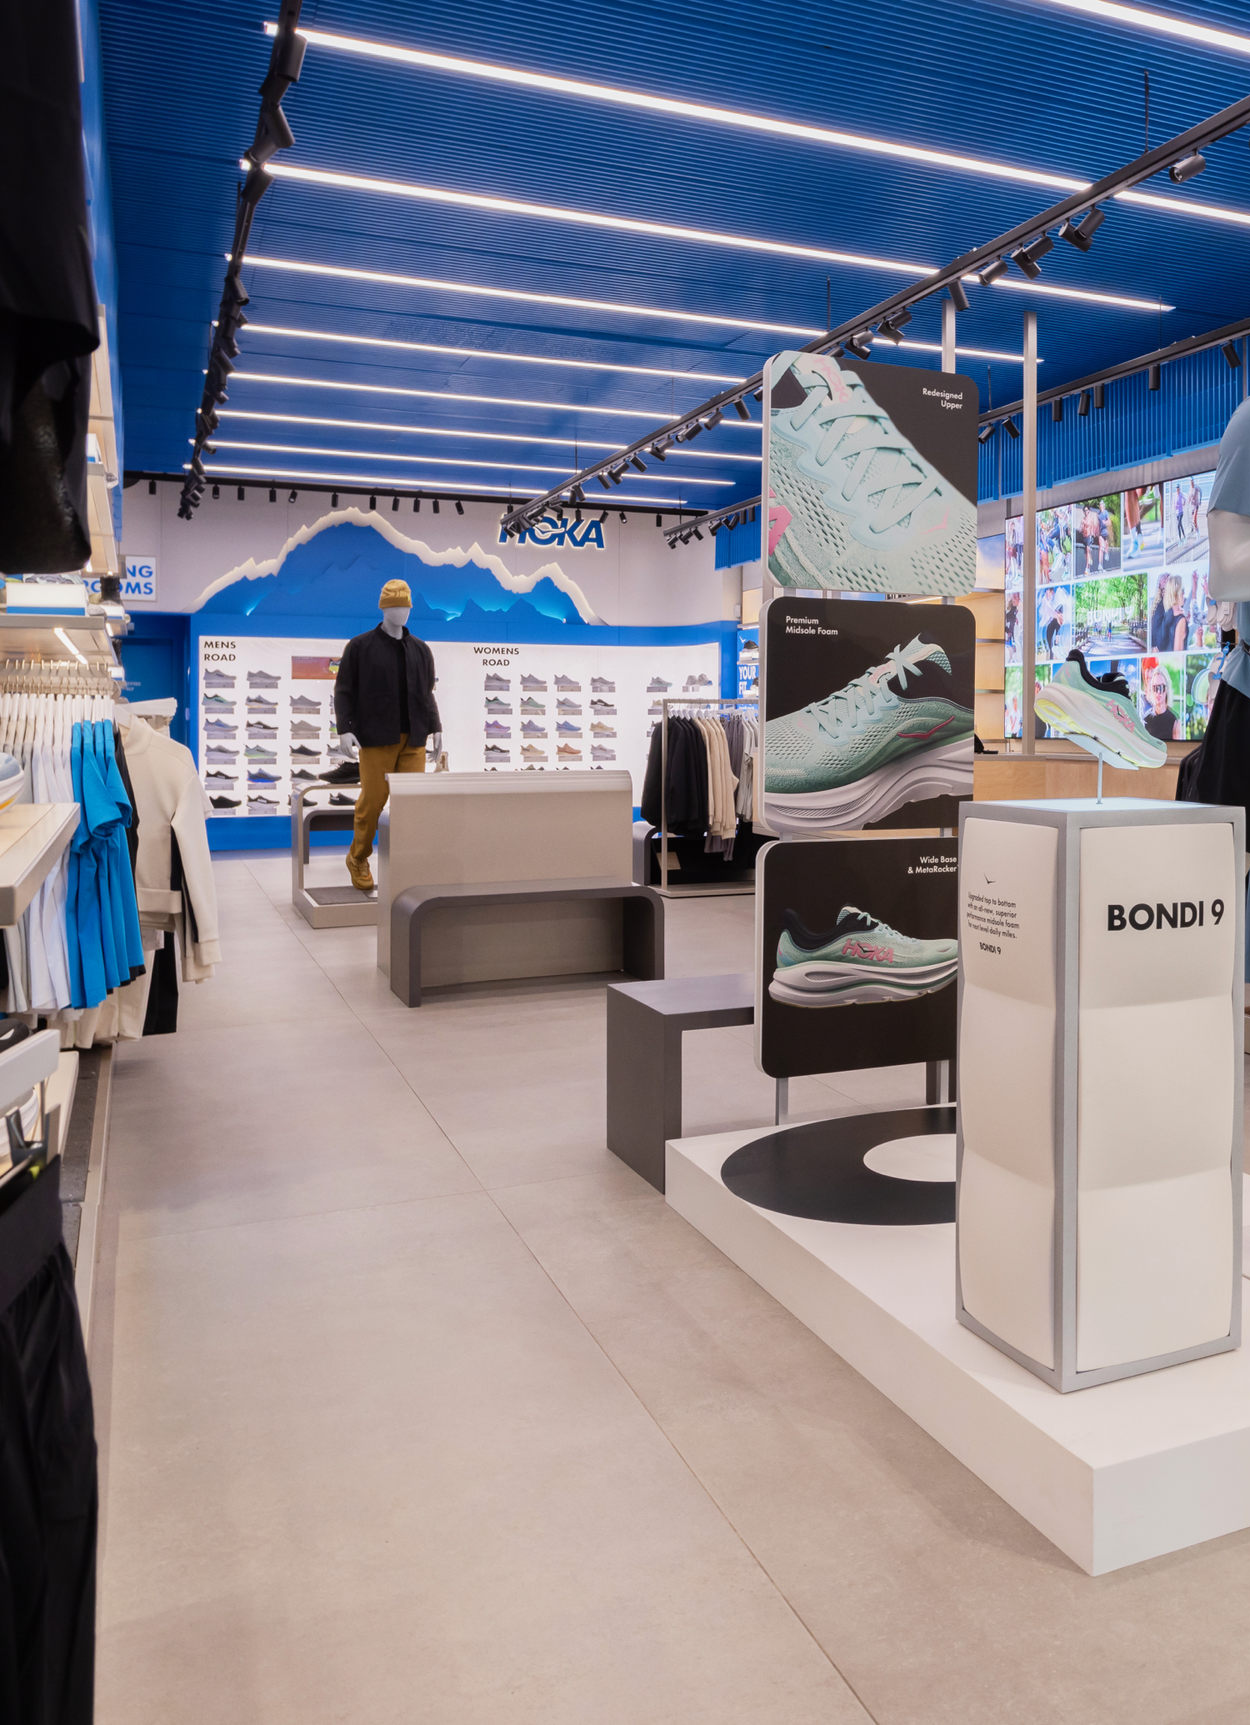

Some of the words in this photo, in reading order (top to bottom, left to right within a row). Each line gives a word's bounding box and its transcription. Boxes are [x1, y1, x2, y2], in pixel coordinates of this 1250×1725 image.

[922, 387, 963, 400] Redesigned
[941, 399, 963, 410] Upper
[82, 579, 154, 595] OMS
[785, 615, 819, 625] Premium
[785, 625, 816, 634] Midsole
[817, 626, 839, 635] Foam
[203, 641, 236, 649] MENS
[473, 646, 520, 655] WOMENS
[203, 653, 236, 661] ROAD
[482, 658, 510, 666] ROAD
[738, 665, 757, 680] YOUR
[1106, 699, 1136, 733] HOKA
[919, 855, 939, 864] Wide
[940, 855, 957, 863] Base
[907, 866, 914, 874] &
[997, 897, 1016, 908] bottom
[995, 909, 1017, 918] superior
[1107, 900, 1204, 931] BONDI
[1211, 898, 1225, 925] 9
[987, 916, 1004, 926] midsole
[1005, 919, 1020, 929] foam
[989, 926, 1001, 937] daily
[1001, 929, 1017, 939] miles.
[841, 938, 894, 963] HOKA
[979, 941, 996, 954] BONDI
[996, 946, 1002, 955] 9
